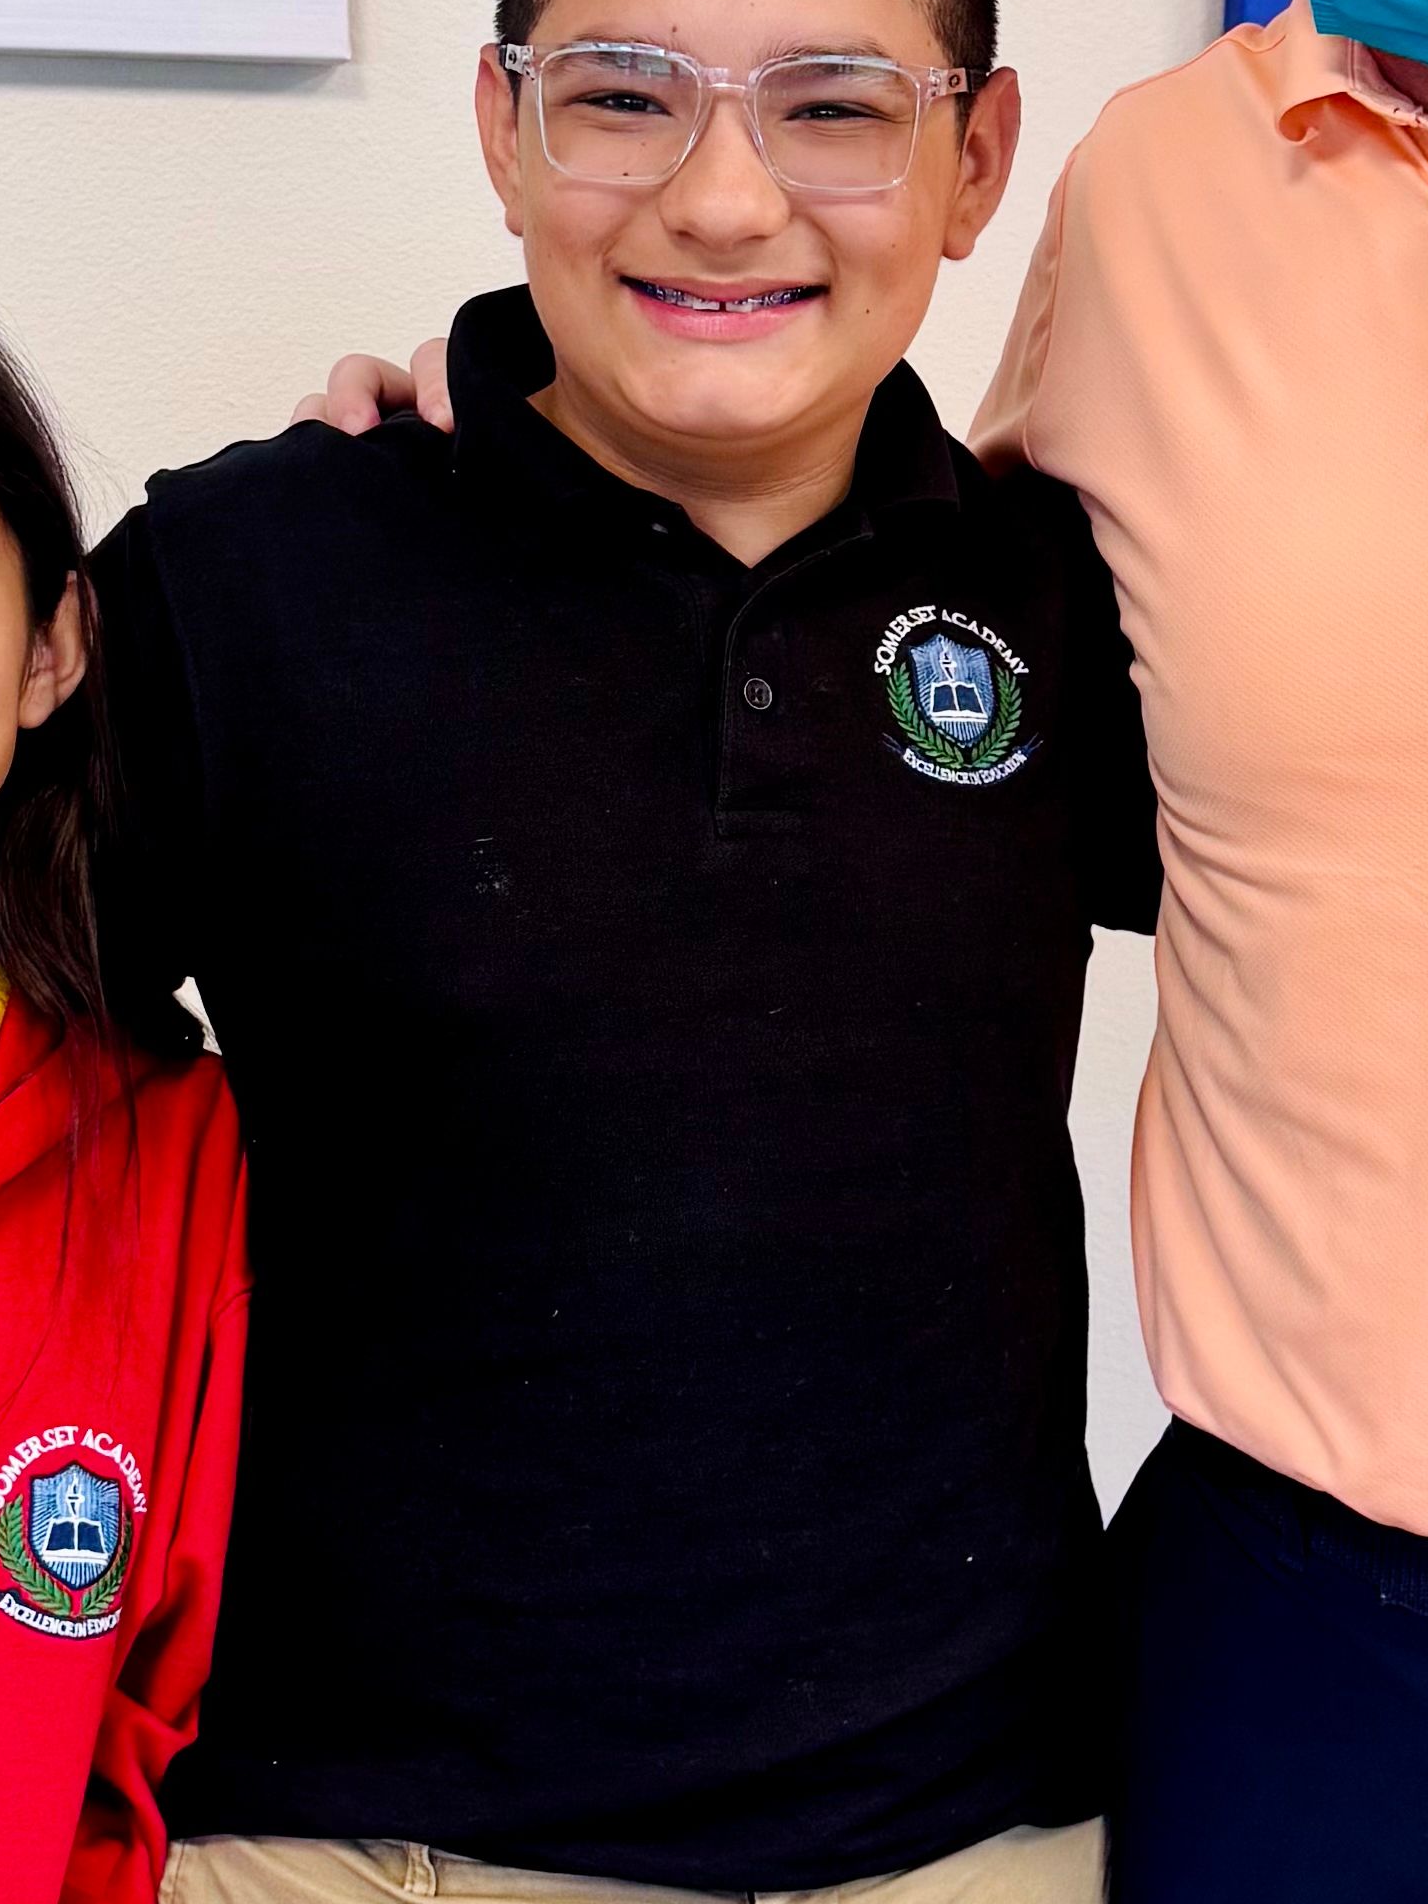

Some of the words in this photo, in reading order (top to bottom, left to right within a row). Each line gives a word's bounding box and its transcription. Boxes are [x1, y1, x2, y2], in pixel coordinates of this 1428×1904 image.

[873, 604, 937, 676] SOMERSET
[940, 608, 1030, 676] ACADEMY
[80, 1428, 148, 1514] ACADEMY
